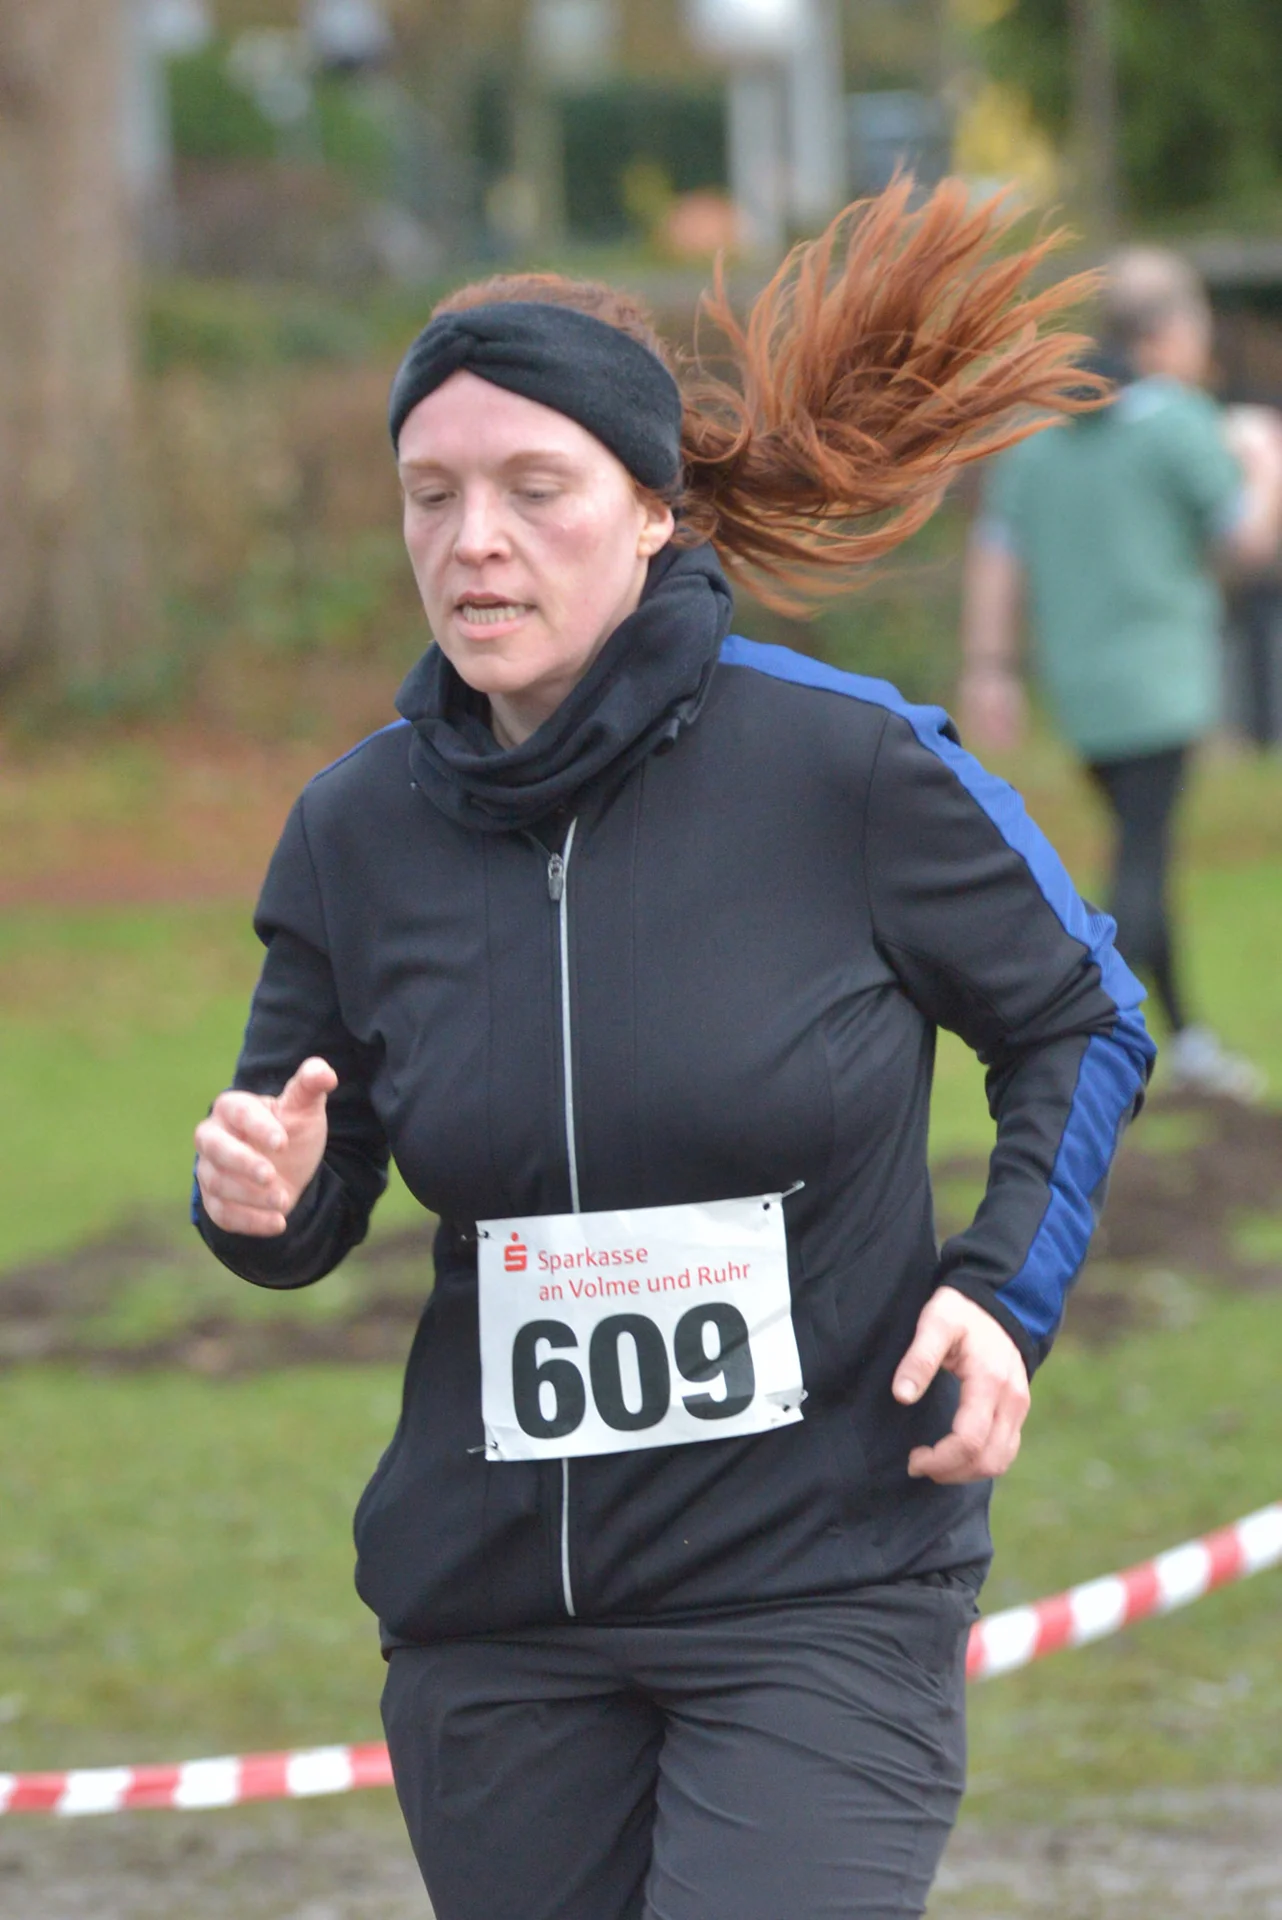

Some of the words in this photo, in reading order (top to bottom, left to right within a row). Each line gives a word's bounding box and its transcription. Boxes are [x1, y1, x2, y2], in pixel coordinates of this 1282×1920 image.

[537, 1246, 649, 1275] Sparkasse
[538, 1284, 564, 1302] an
[568, 1275, 641, 1300] Volme
[647, 1268, 692, 1294] und
[698, 1261, 751, 1287] Ruhr
[511, 1301, 756, 1440] 609
